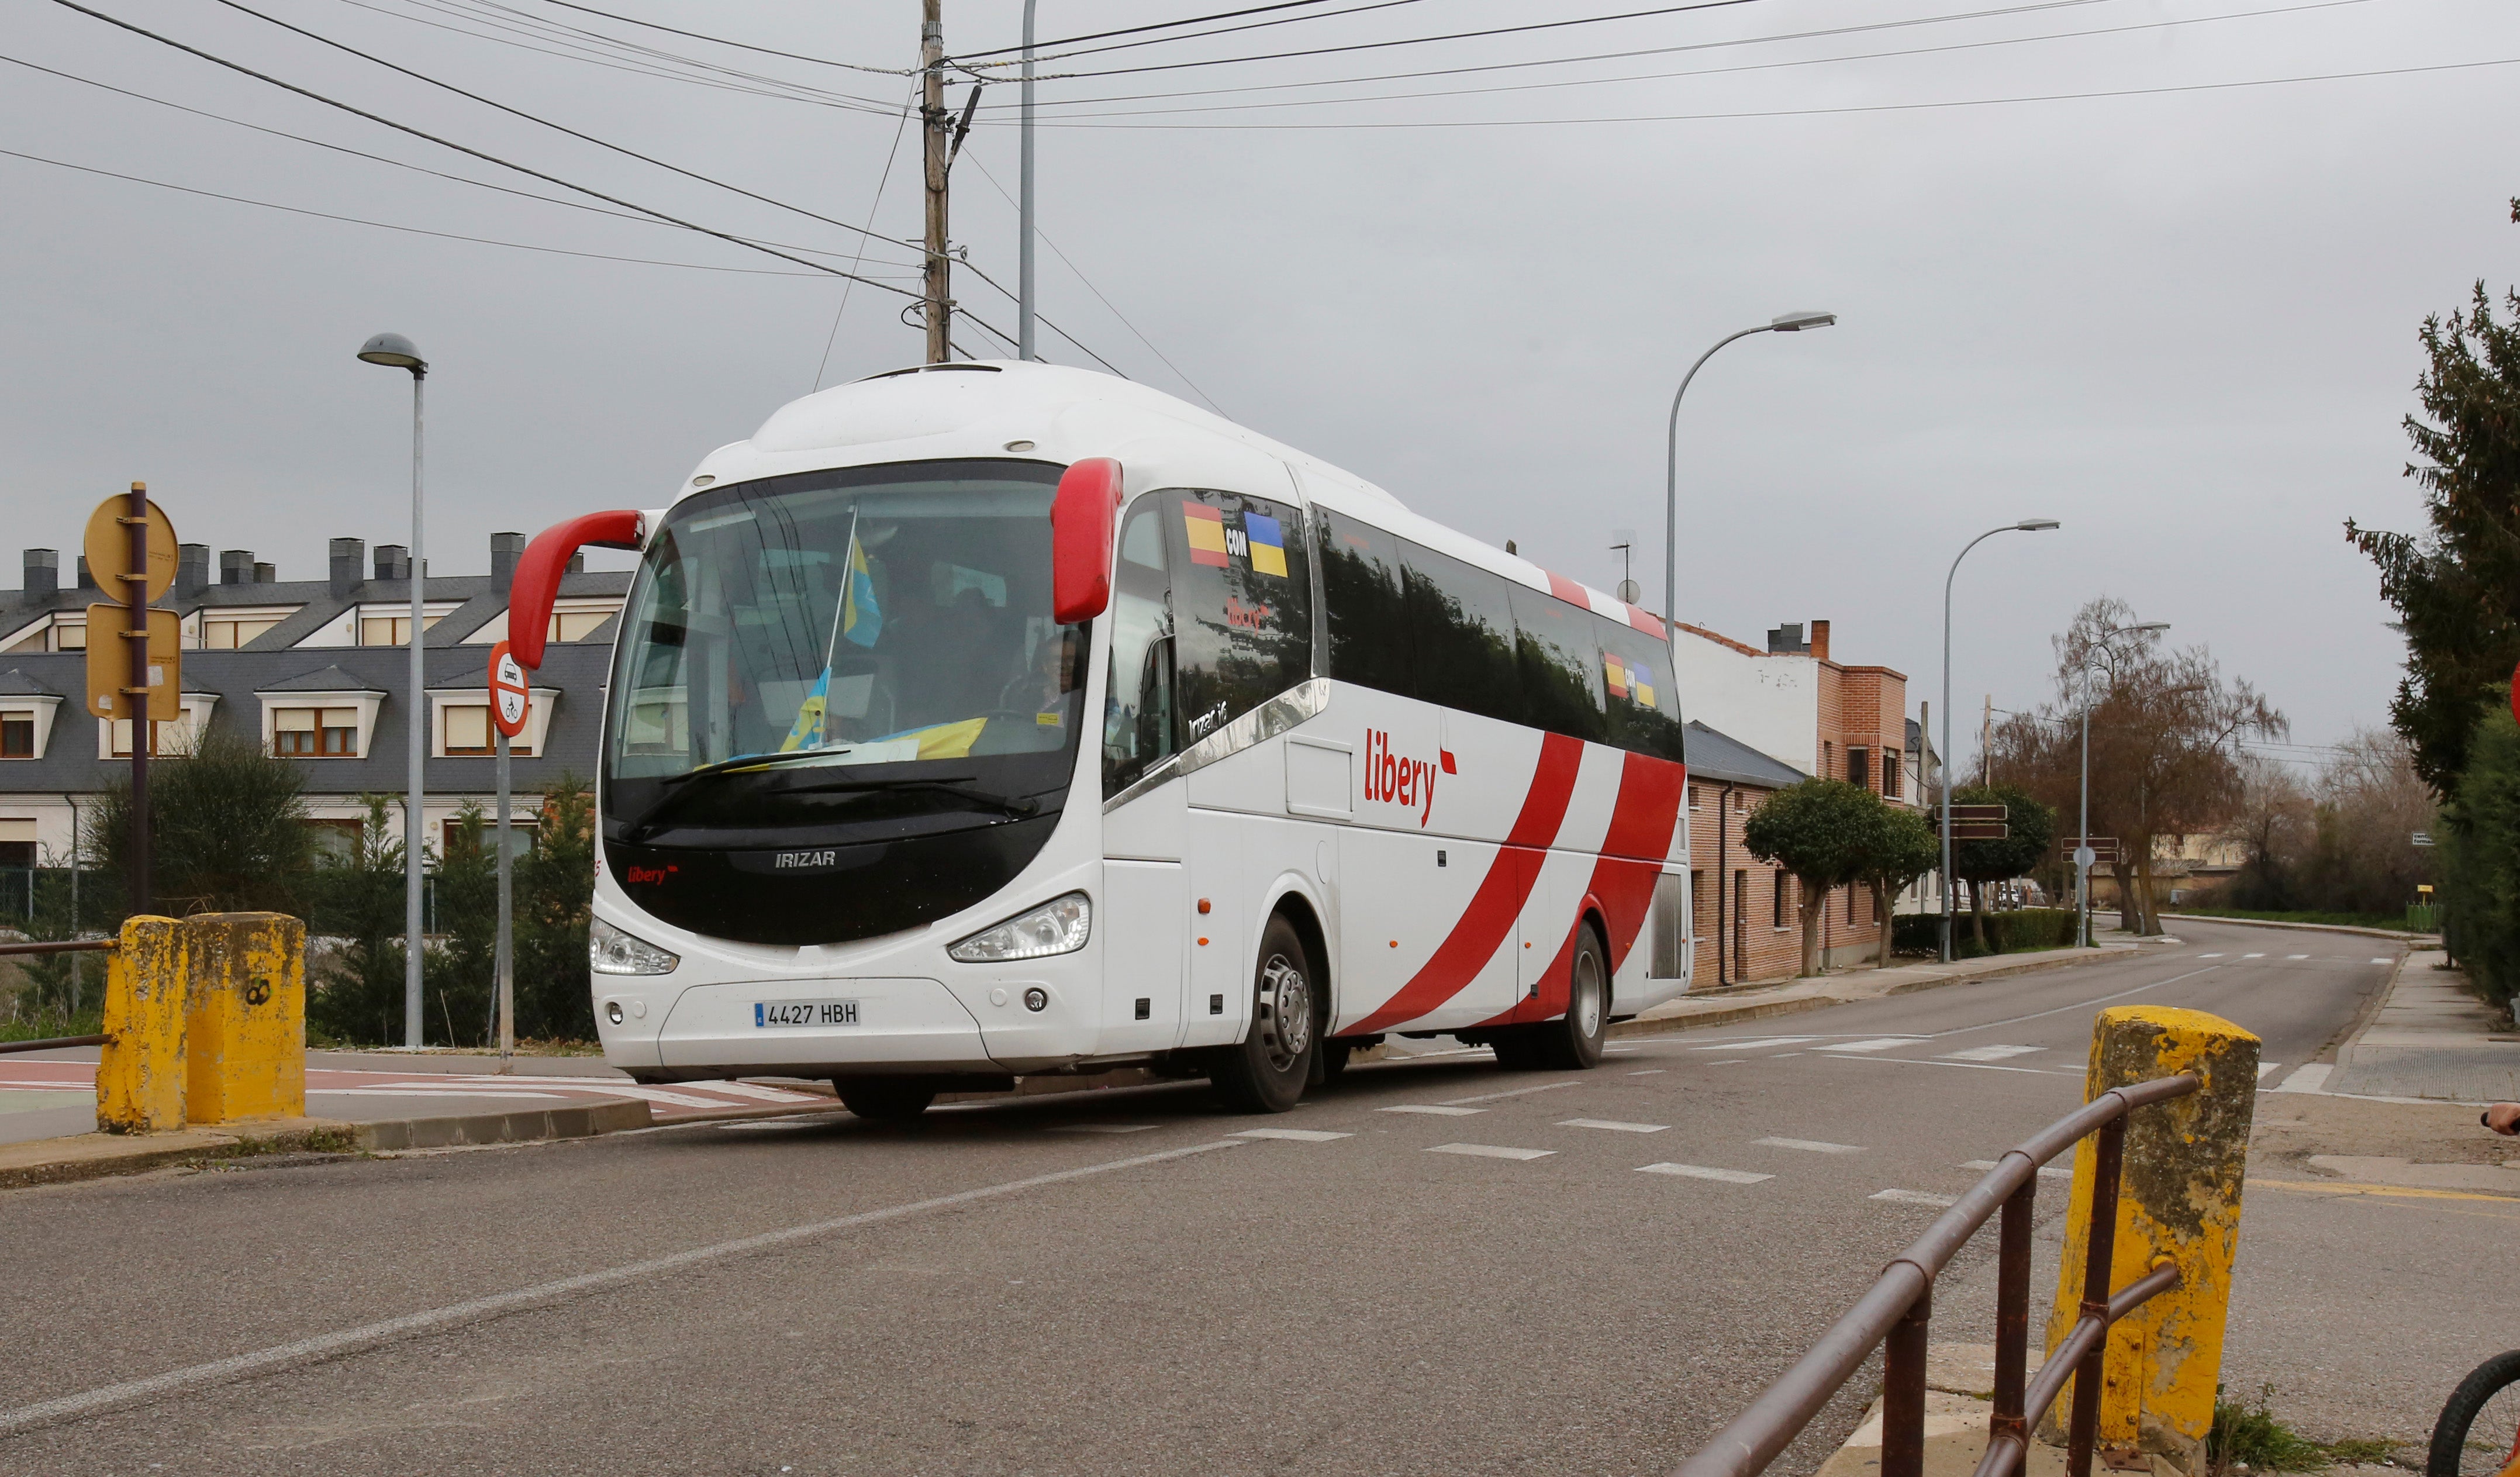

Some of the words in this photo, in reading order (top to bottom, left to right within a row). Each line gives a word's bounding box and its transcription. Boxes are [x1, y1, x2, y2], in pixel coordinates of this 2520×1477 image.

[1226, 528, 1247, 557] CON
[1365, 728, 1437, 829] libery
[775, 851, 836, 868] IRIZAR
[627, 866, 665, 886] libery
[768, 1005, 813, 1024] 4427
[821, 1004, 857, 1023] HBH
